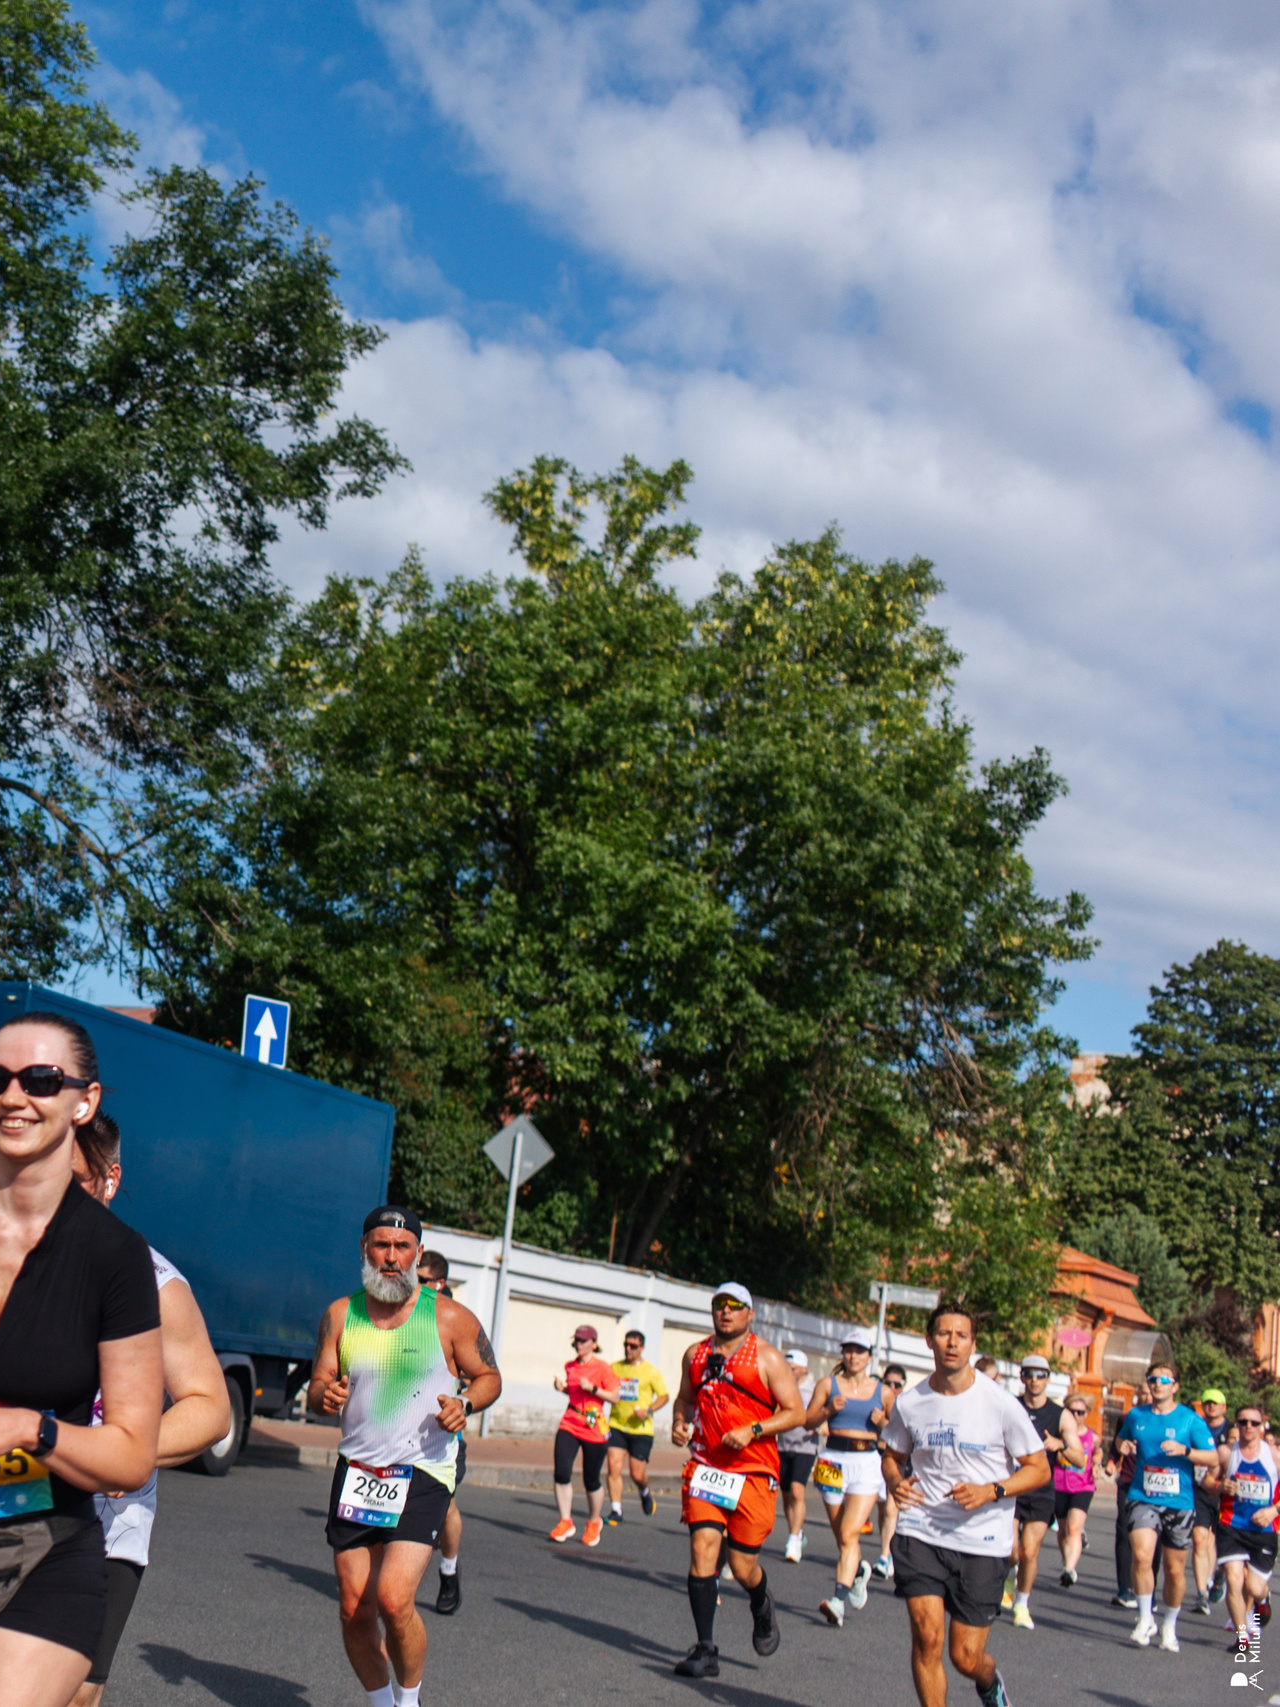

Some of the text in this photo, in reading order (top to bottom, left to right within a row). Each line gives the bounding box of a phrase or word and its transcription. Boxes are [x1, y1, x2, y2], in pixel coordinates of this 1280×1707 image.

[700, 1470, 735, 1490] 6051
[1147, 1474, 1174, 1486] 6423
[353, 1476, 399, 1500] 2906
[1239, 1481, 1264, 1494] 5121
[363, 1498, 385, 1507] РУСЛАН
[343, 1505, 353, 1518] D
